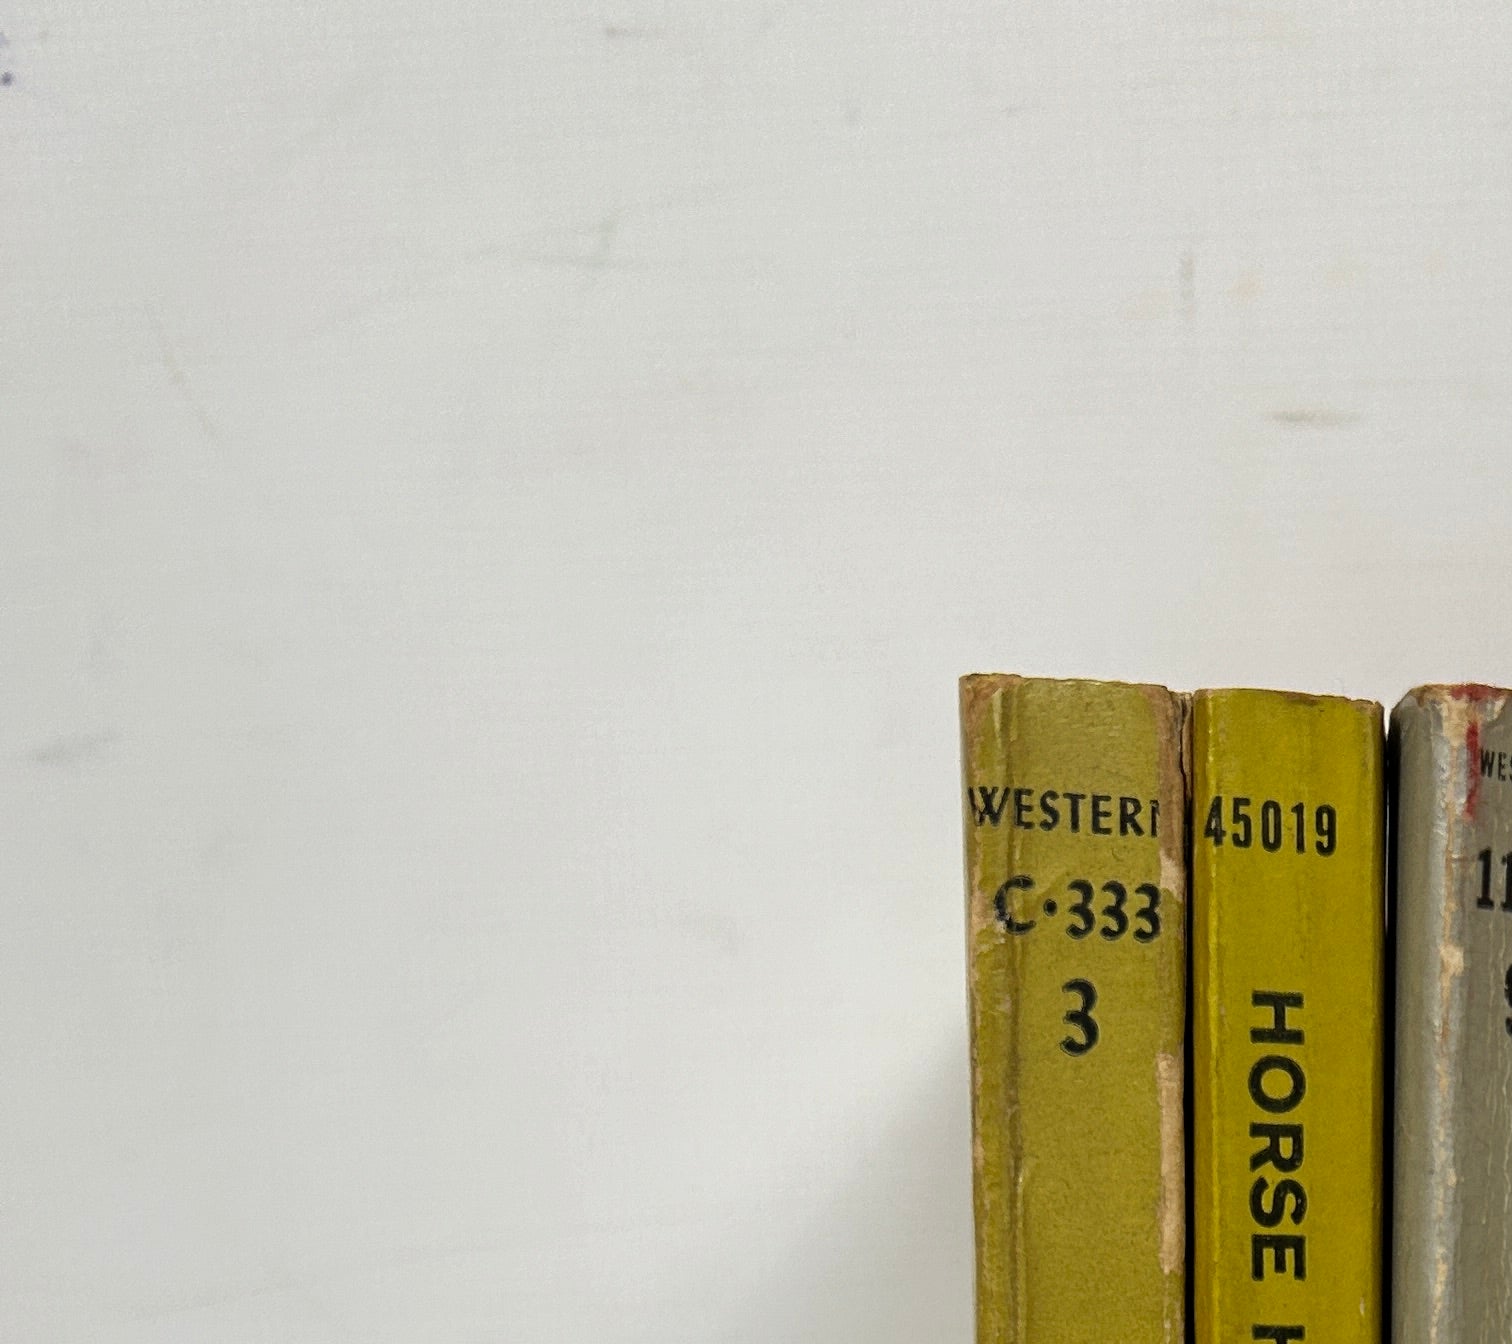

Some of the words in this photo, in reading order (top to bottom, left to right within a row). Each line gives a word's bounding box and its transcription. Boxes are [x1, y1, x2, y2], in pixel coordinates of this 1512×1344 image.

[1203, 796, 1338, 857] 45019
[1060, 977, 1100, 1057] 3
[1246, 990, 1306, 1282] HORSE
